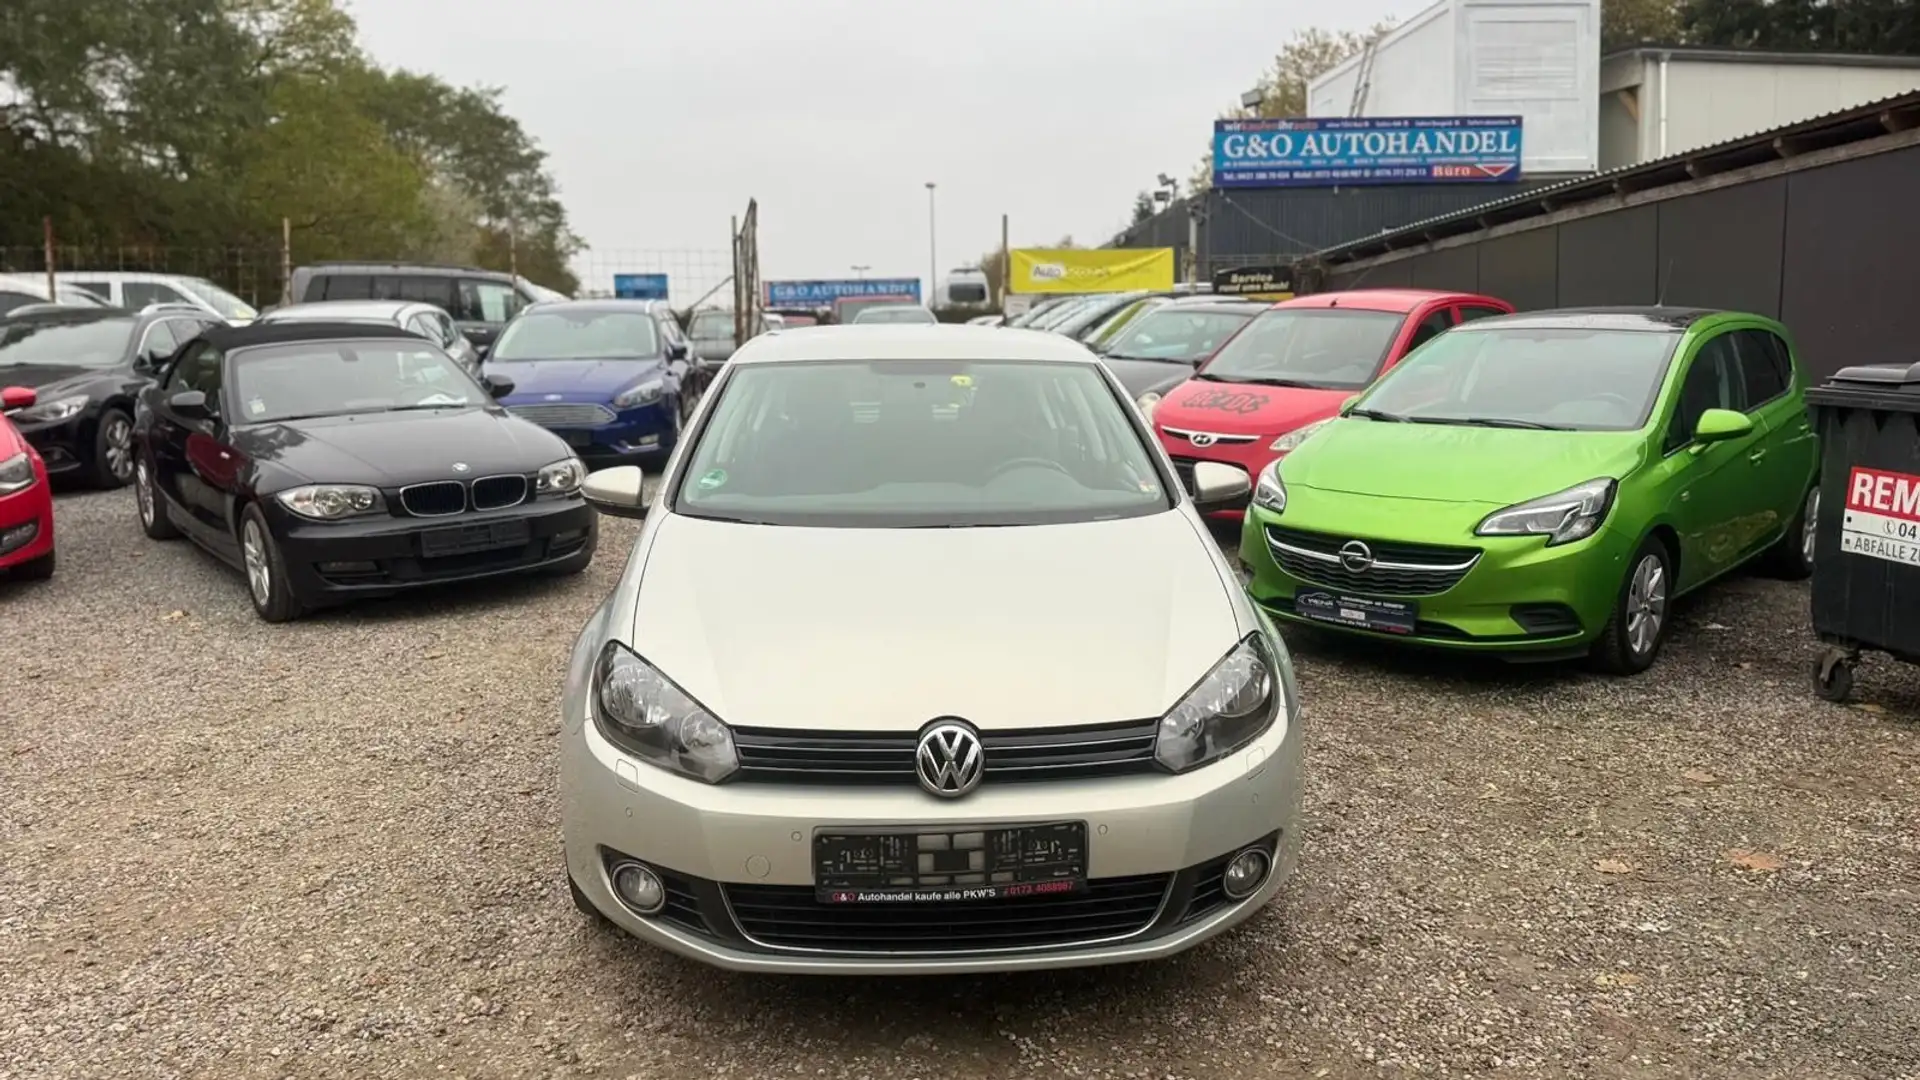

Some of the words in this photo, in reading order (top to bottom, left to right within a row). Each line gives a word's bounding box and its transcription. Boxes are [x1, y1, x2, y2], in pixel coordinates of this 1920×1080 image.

[1223, 134, 1292, 158] G&O
[1300, 130, 1517, 157] AUTOHANDEL
[1433, 165, 1470, 178] Büro
[1033, 265, 1061, 278] Auto
[1230, 273, 1273, 284] Service
[774, 286, 808, 297] G&O
[1854, 537, 1906, 560] ABFÄLLE
[857, 891, 913, 902] Autohandel
[915, 890, 942, 901] kaufe
[943, 890, 962, 900] alle
[963, 888, 996, 899] PKW'S
